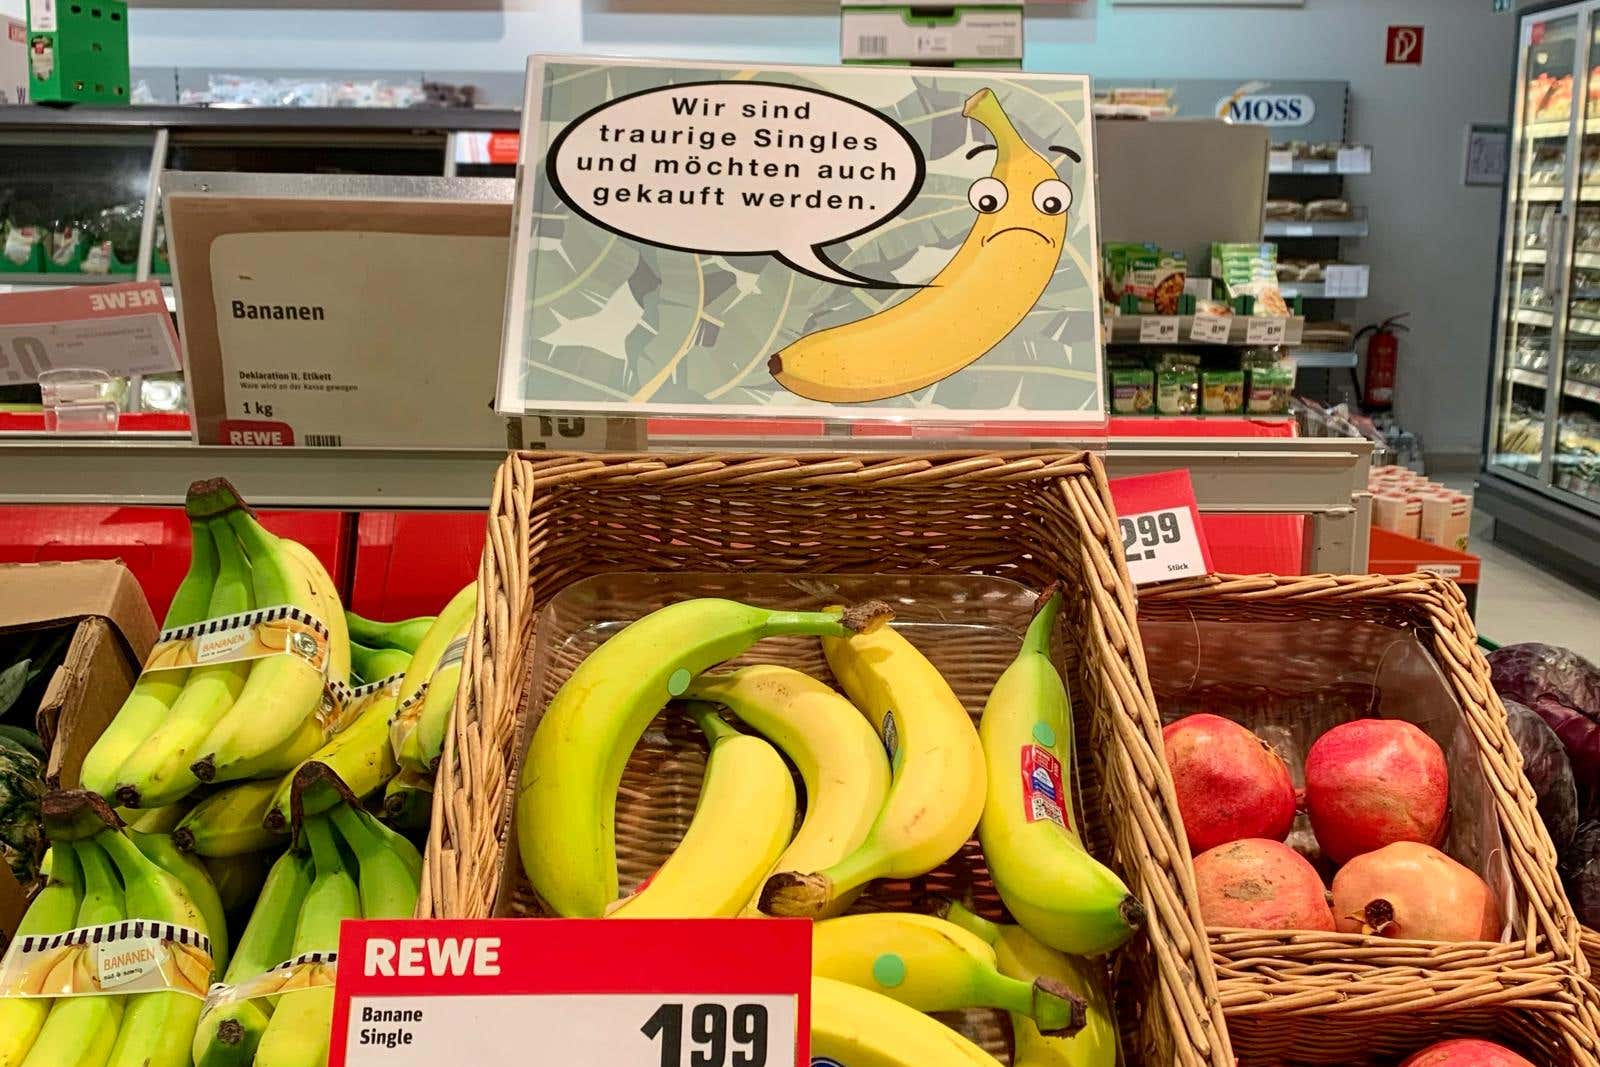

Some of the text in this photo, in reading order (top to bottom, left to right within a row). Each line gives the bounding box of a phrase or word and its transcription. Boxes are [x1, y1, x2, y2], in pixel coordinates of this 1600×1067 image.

[672, 97, 811, 120] Wir sind
[1230, 99, 1302, 121] MOSS
[599, 124, 878, 153] traurige Singles
[576, 154, 897, 181] und möchten auch
[593, 184, 876, 210] gekauft werden.
[231, 300, 325, 321] Bananen
[239, 371, 290, 380] Deklaration
[302, 372, 332, 381] Etikett
[261, 382, 277, 390] wird
[303, 383, 324, 391] Kasse
[242, 401, 273, 417] 1 kg
[229, 431, 283, 446] REWE
[1167, 562, 1189, 572] Stück
[203, 632, 246, 652] BANANEN
[103, 947, 155, 971] BANANEN
[363, 937, 501, 977] REWE
[361, 1006, 424, 1023] Banane
[359, 1030, 413, 1047] Single
